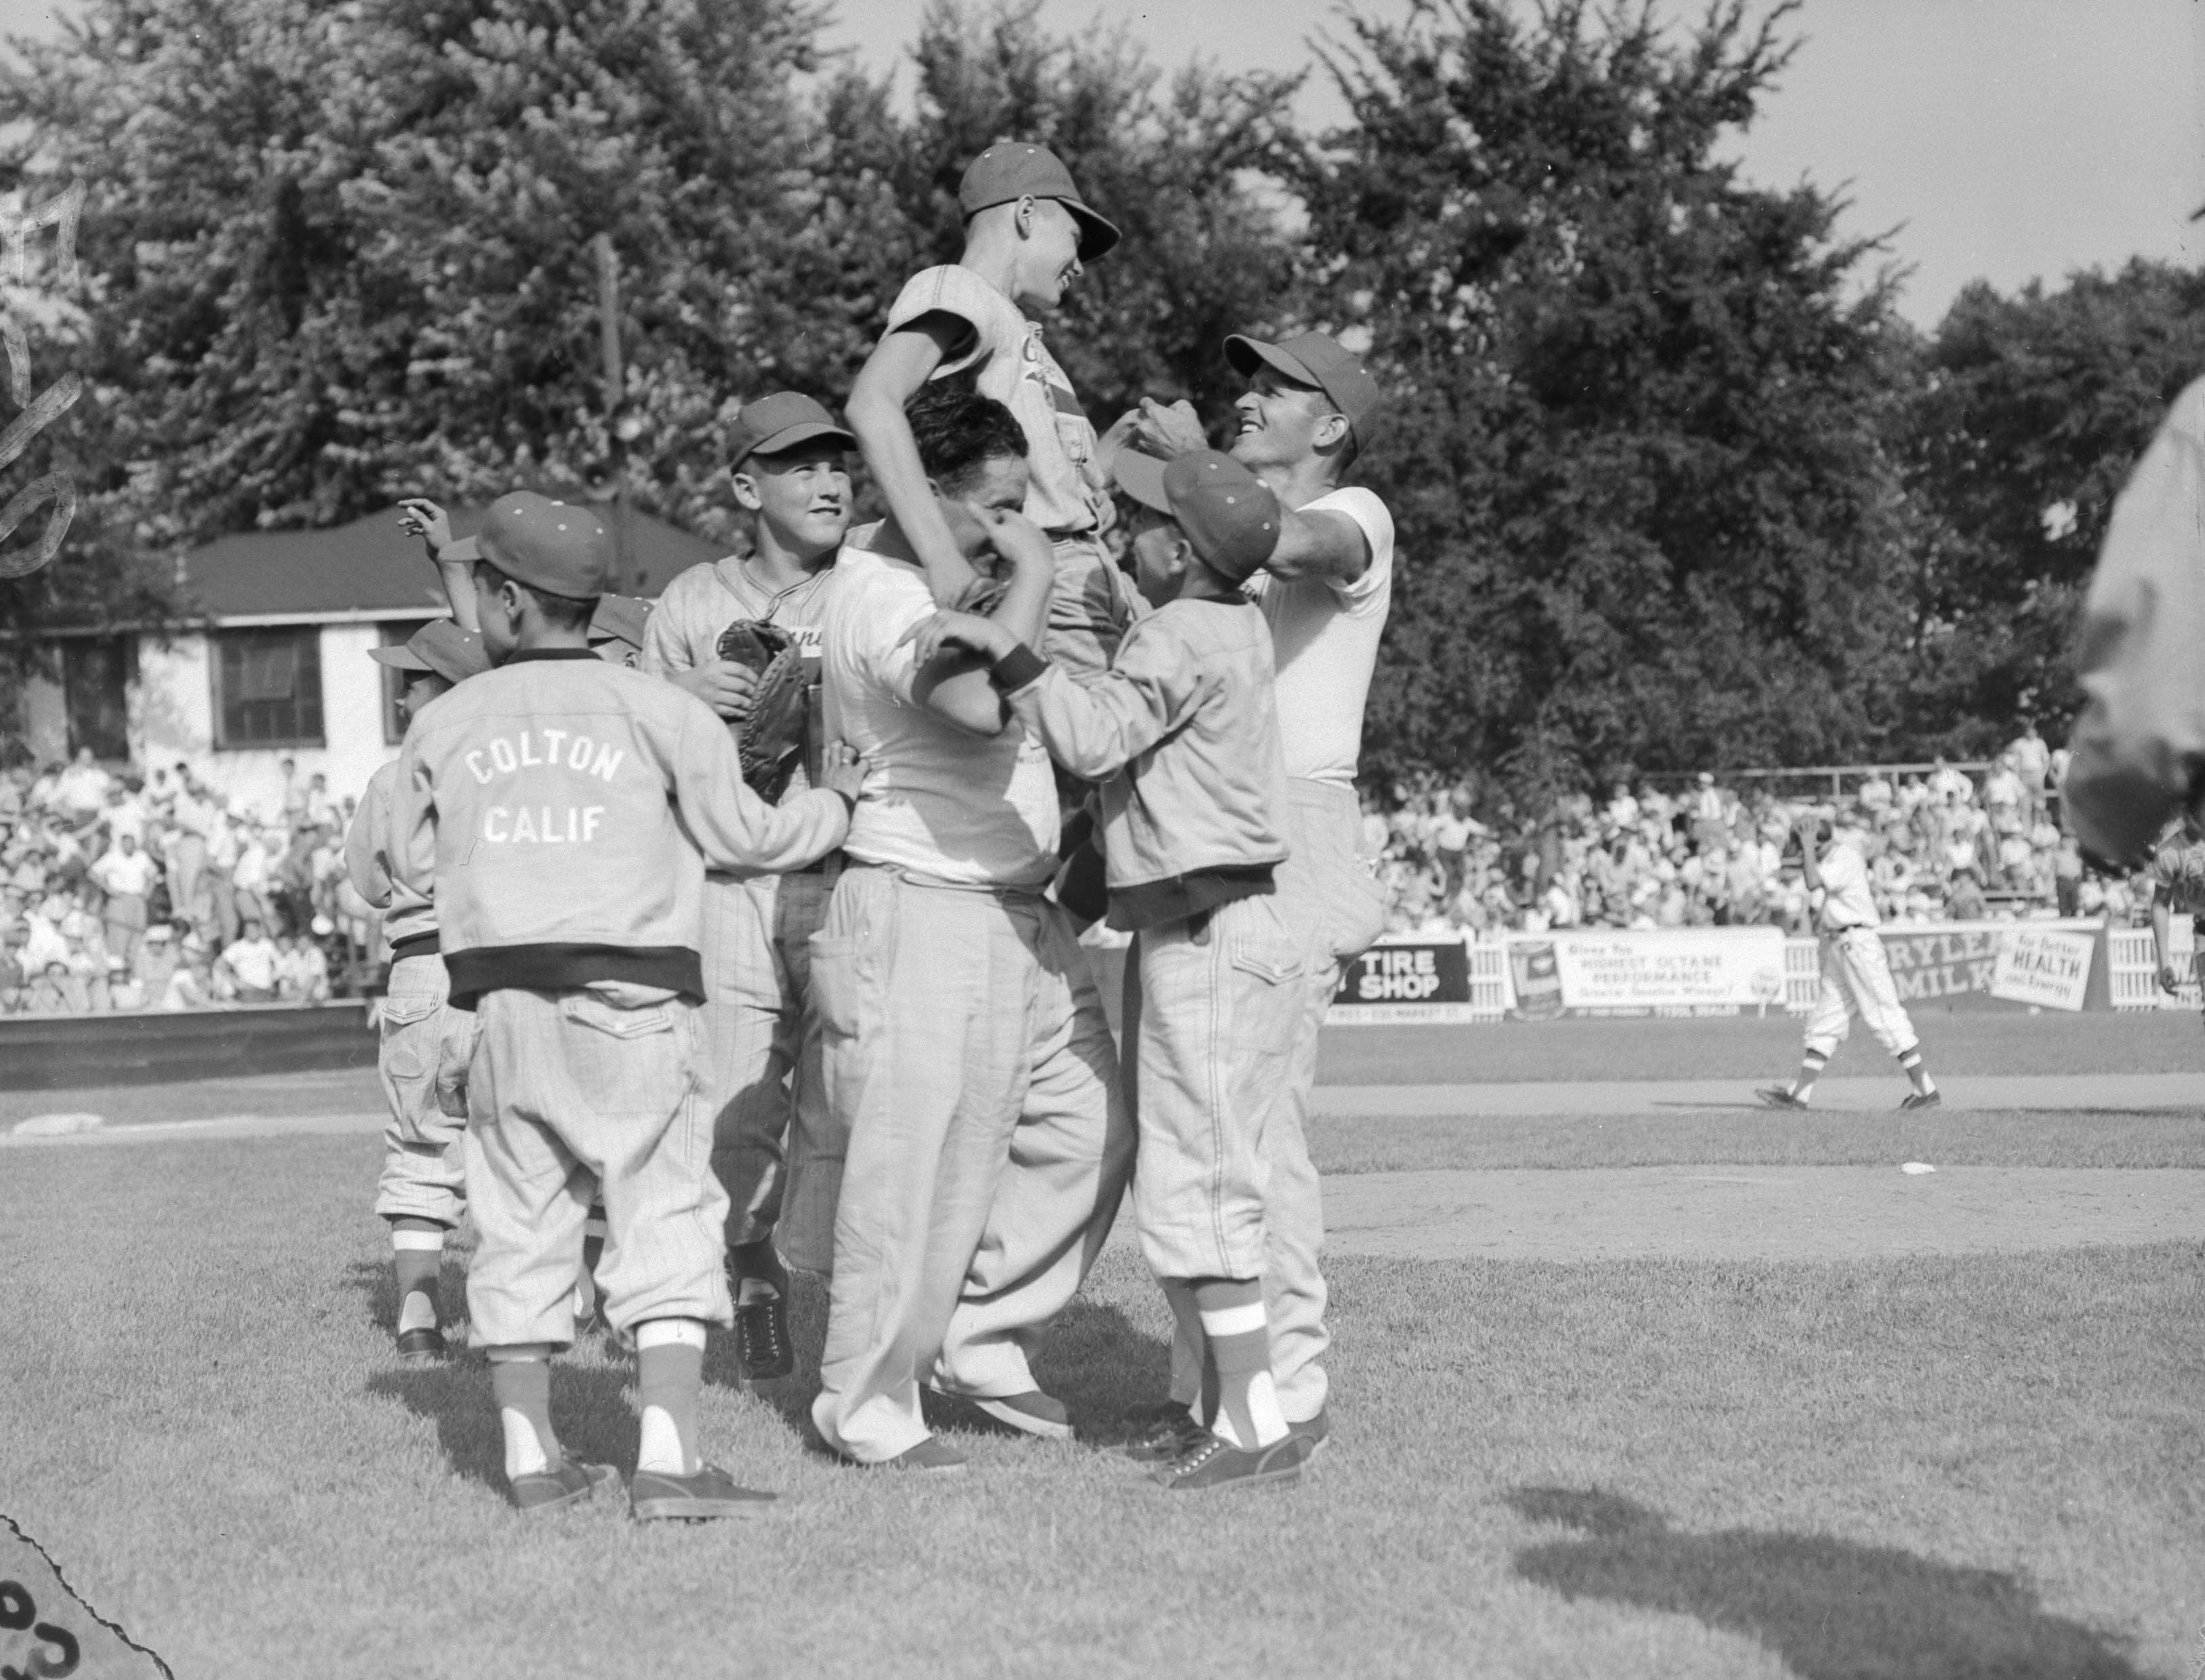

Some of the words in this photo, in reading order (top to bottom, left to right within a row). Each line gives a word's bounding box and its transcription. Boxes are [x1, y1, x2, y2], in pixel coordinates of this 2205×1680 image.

[465, 728, 625, 784] COLTON
[484, 807, 605, 842] CALIF
[1357, 949, 1436, 974] TIRE
[1656, 955, 1722, 968] OCTANE
[2013, 951, 2082, 979] HEALTH
[1358, 974, 1440, 999] SHOP
[1593, 971, 1711, 983] PERFORMANCE
[1892, 959, 1996, 1000] MILK
